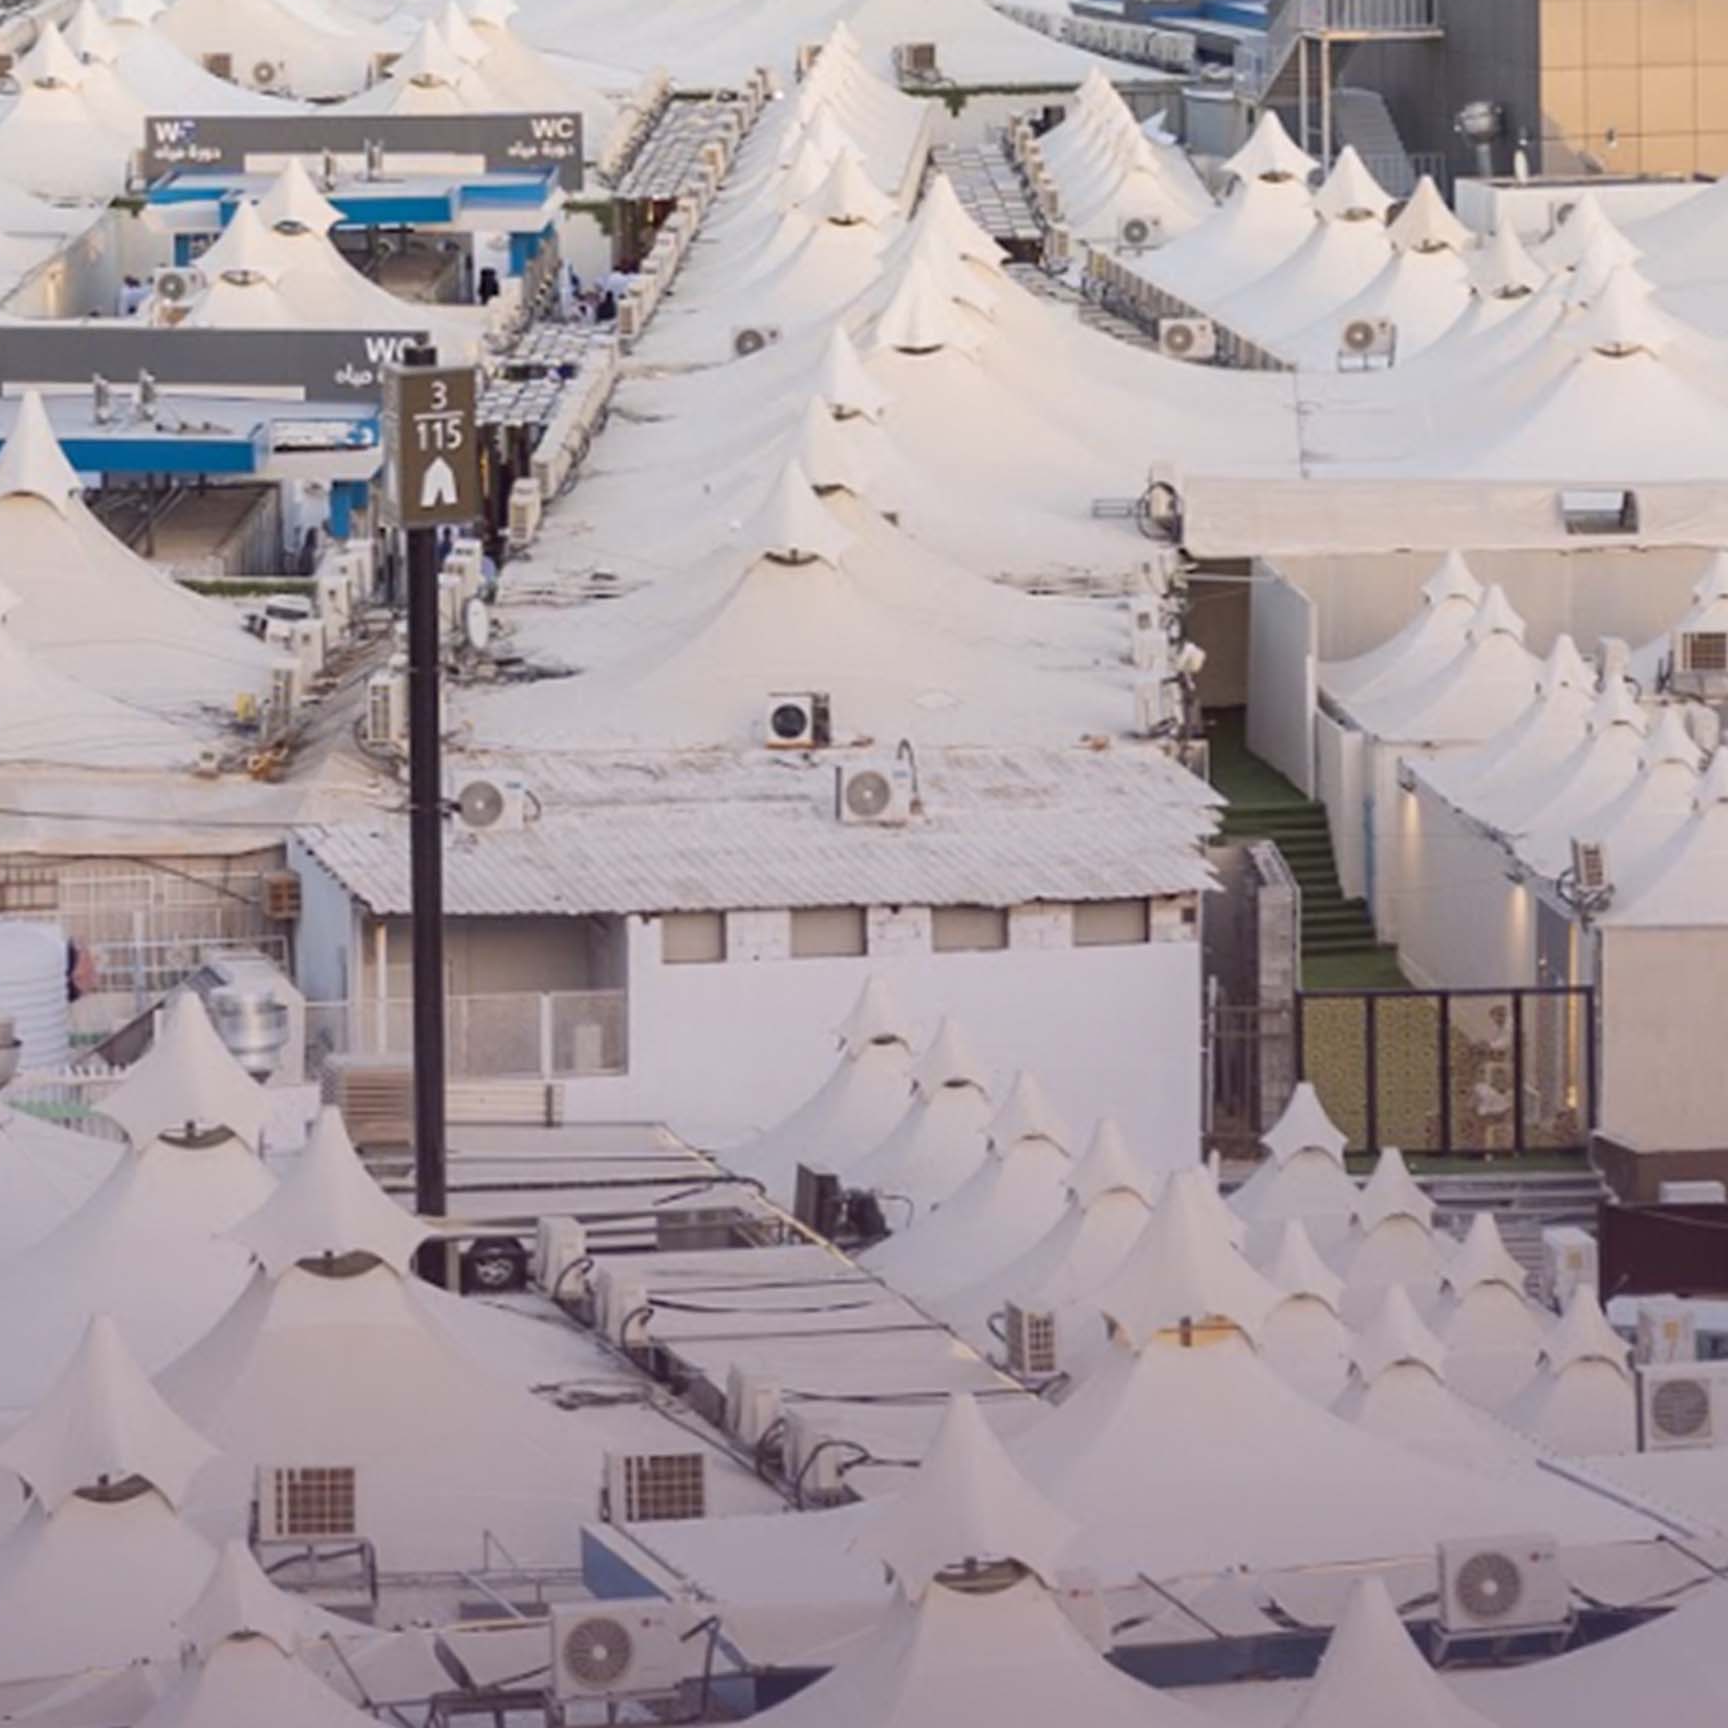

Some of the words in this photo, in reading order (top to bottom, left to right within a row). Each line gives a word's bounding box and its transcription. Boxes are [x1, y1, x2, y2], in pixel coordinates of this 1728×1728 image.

[531, 117, 573, 139] WC
[431, 381, 447, 410] 3
[417, 420, 463, 451] 115
